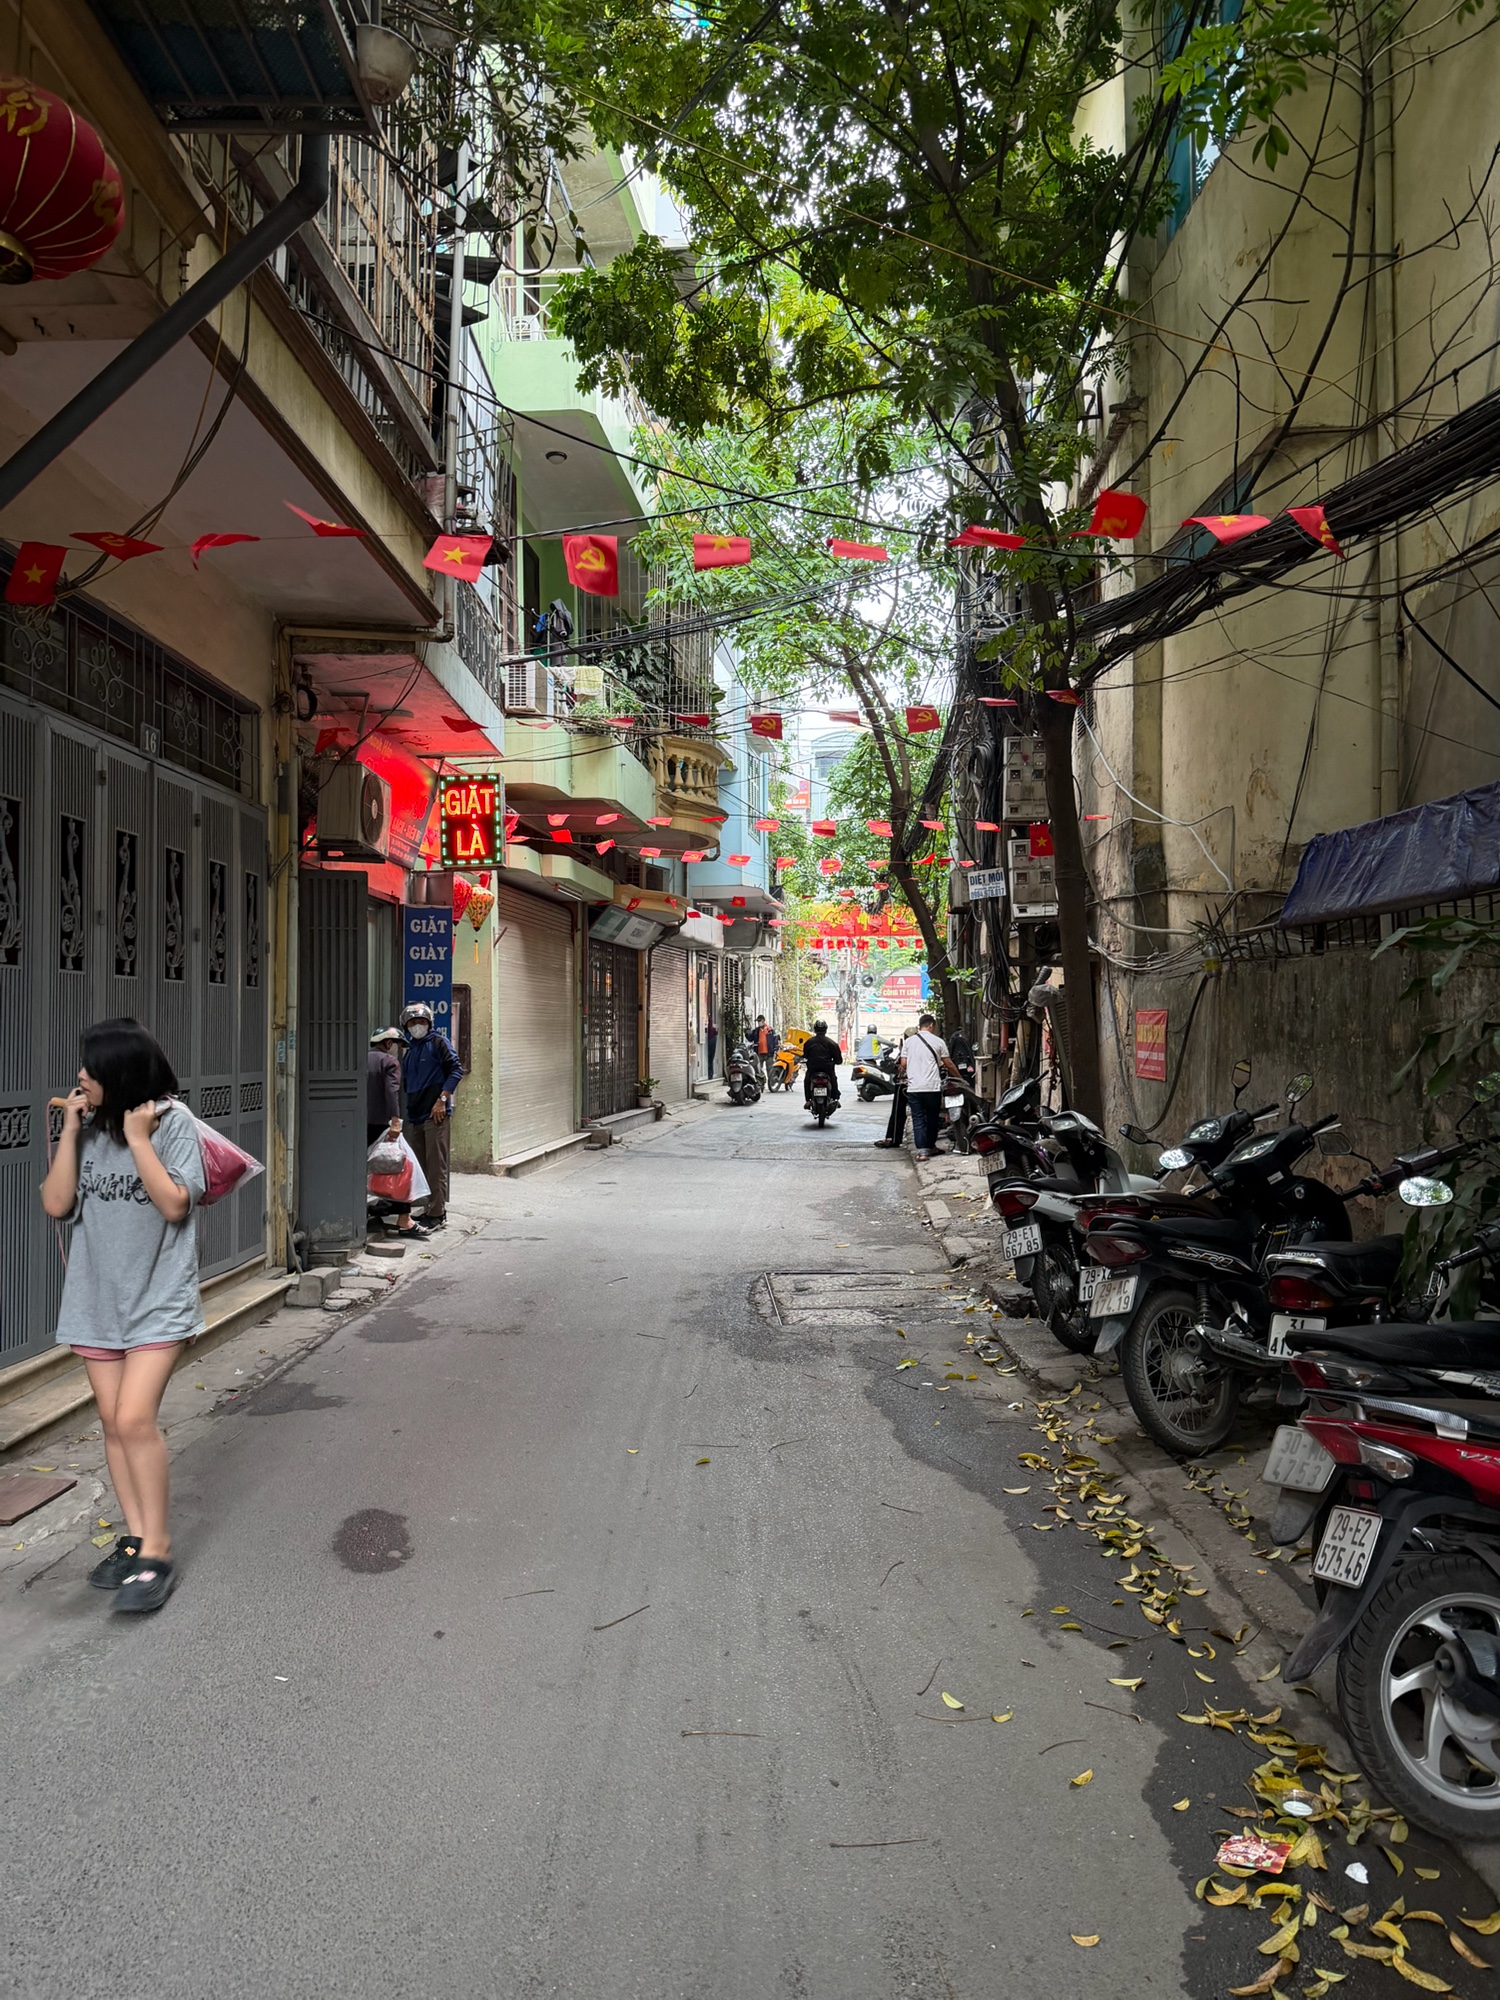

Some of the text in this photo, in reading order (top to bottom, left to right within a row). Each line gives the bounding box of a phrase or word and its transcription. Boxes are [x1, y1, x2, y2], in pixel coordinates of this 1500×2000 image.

[145, 730, 156, 753] 16
[445, 784, 494, 819] GIẶT
[456, 823, 486, 856] LÀ
[410, 915, 447, 937] GIẶT
[409, 942, 447, 960] GIÀY
[413, 970, 444, 987] DÉP
[1007, 1226, 1034, 1245] 29-E1
[1005, 1238, 1039, 1259] 667.85
[1099, 1279, 1129, 1298] 29-AC
[1094, 1295, 1130, 1315] 174.19
[1331, 1513, 1372, 1548] 29-E2
[1317, 1543, 1366, 1582] 575.46
